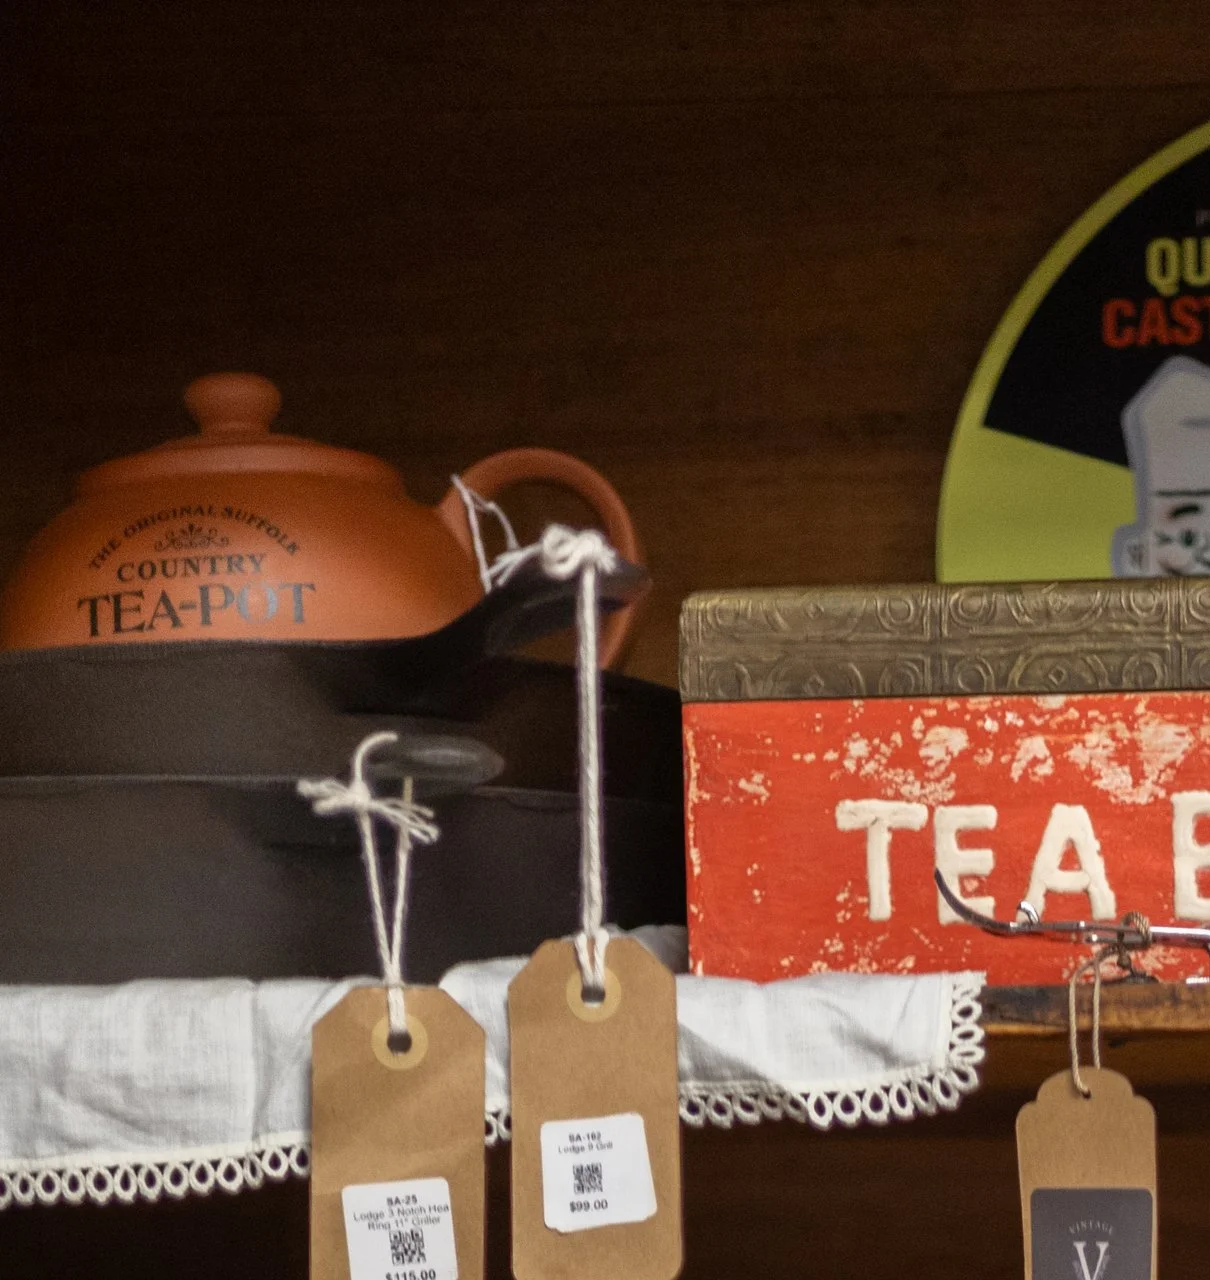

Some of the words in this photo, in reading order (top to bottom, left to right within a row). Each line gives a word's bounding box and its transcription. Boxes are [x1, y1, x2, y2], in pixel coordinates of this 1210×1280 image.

[90, 538, 121, 570] THE
[121, 504, 217, 538] ORIGINAL
[222, 505, 301, 556] SUFFOLK
[116, 553, 266, 583] COUNTRY
[77, 580, 316, 638] TEA-POT
[835, 798, 1116, 924] TEA
[353, 1210, 385, 1223] Lodge
[388, 1207, 395, 1218] 3
[397, 1205, 426, 1218] Notch
[569, 1199, 608, 1213] $99.00
[367, 1221, 391, 1231] Ring
[1068, 1220, 1114, 1236] VINTAGE
